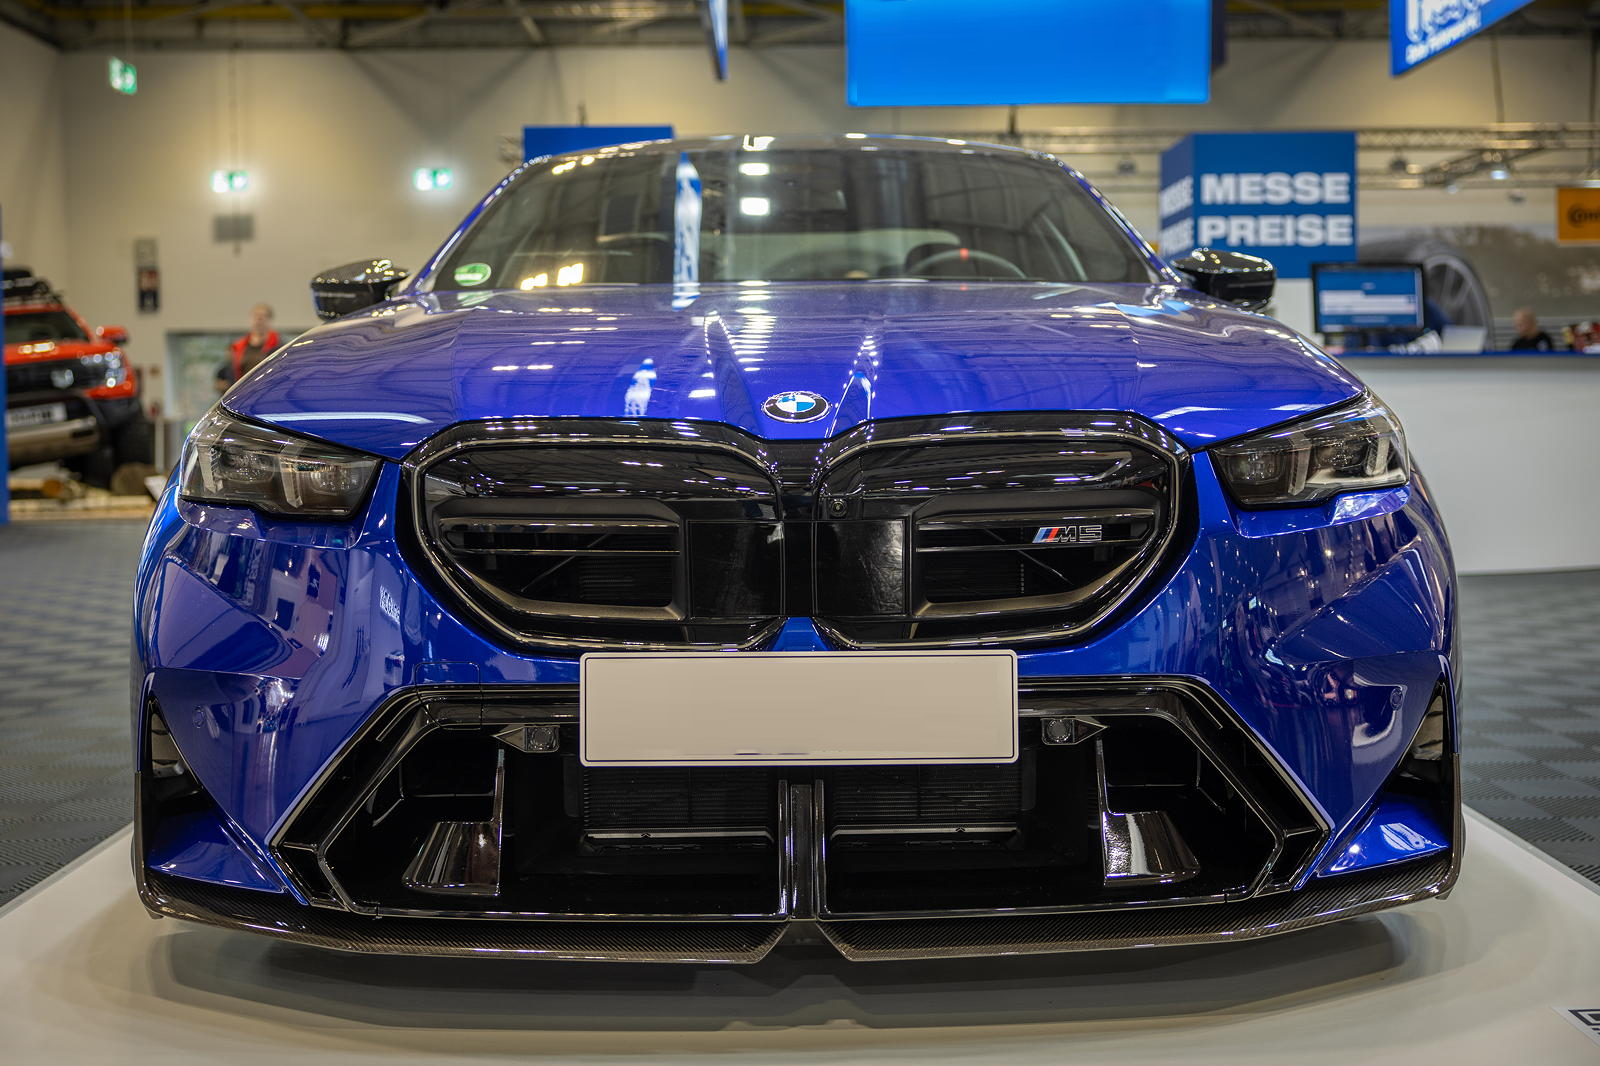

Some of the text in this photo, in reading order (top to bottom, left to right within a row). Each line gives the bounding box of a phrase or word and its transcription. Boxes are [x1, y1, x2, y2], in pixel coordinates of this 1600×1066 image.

[1200, 172, 1350, 205] MESSE
[1198, 213, 1354, 247] PREISE
[1032, 525, 1102, 543] M5
